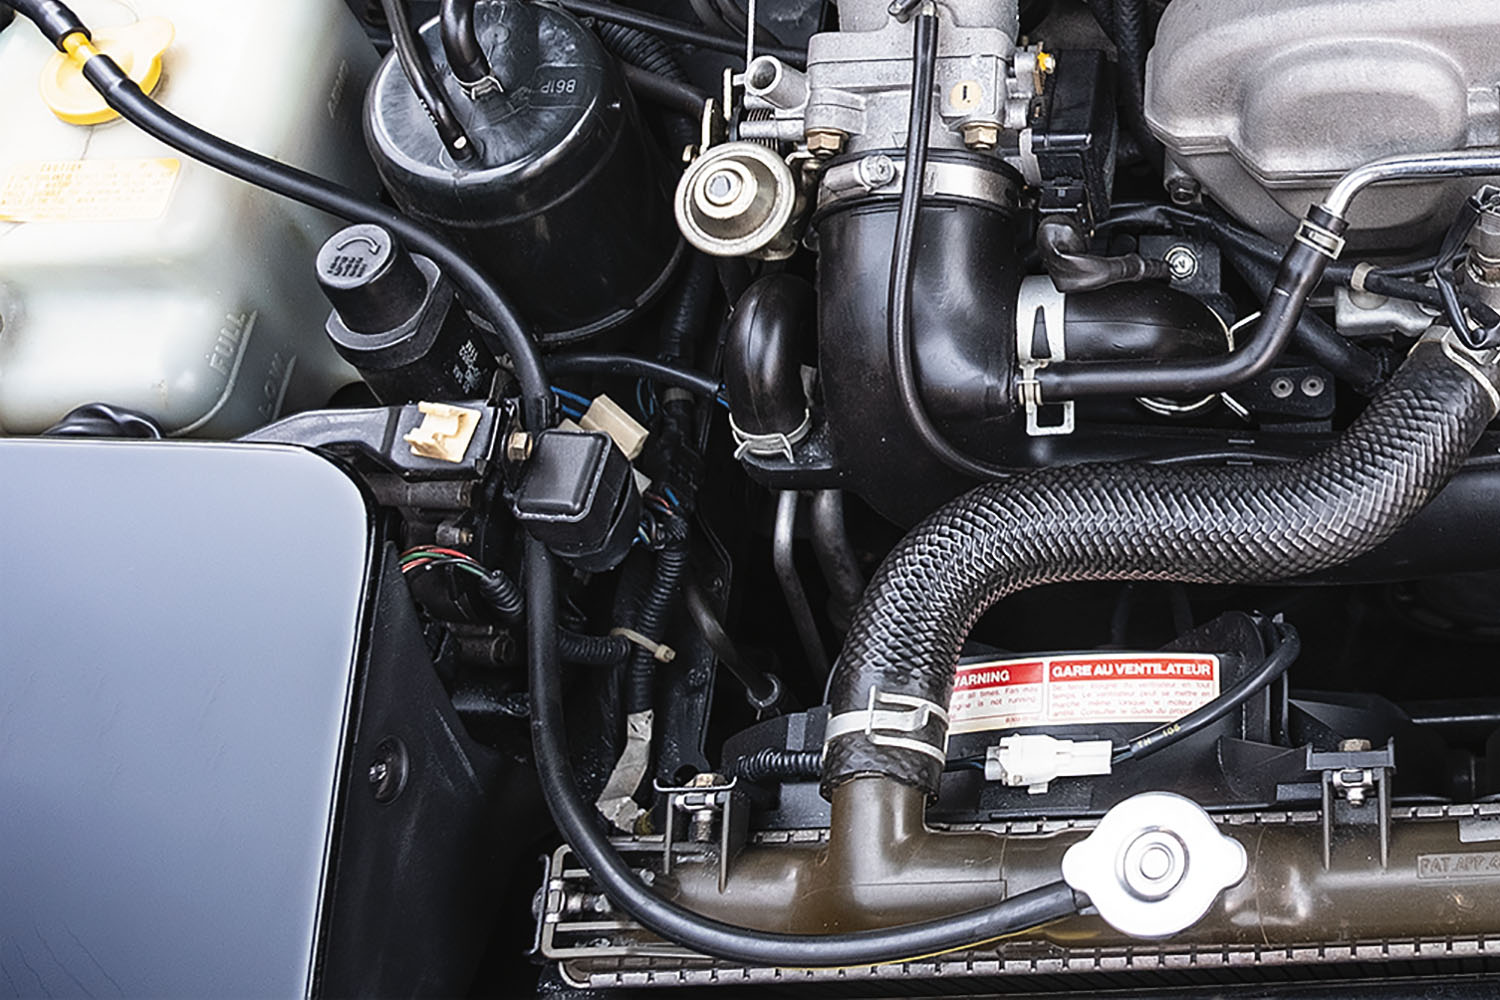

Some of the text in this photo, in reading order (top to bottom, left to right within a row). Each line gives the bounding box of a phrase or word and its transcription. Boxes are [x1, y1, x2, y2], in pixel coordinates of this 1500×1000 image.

[209, 313, 247, 377] FULL
[1051, 661, 1212, 678] GARE AU VENTILATEUR
